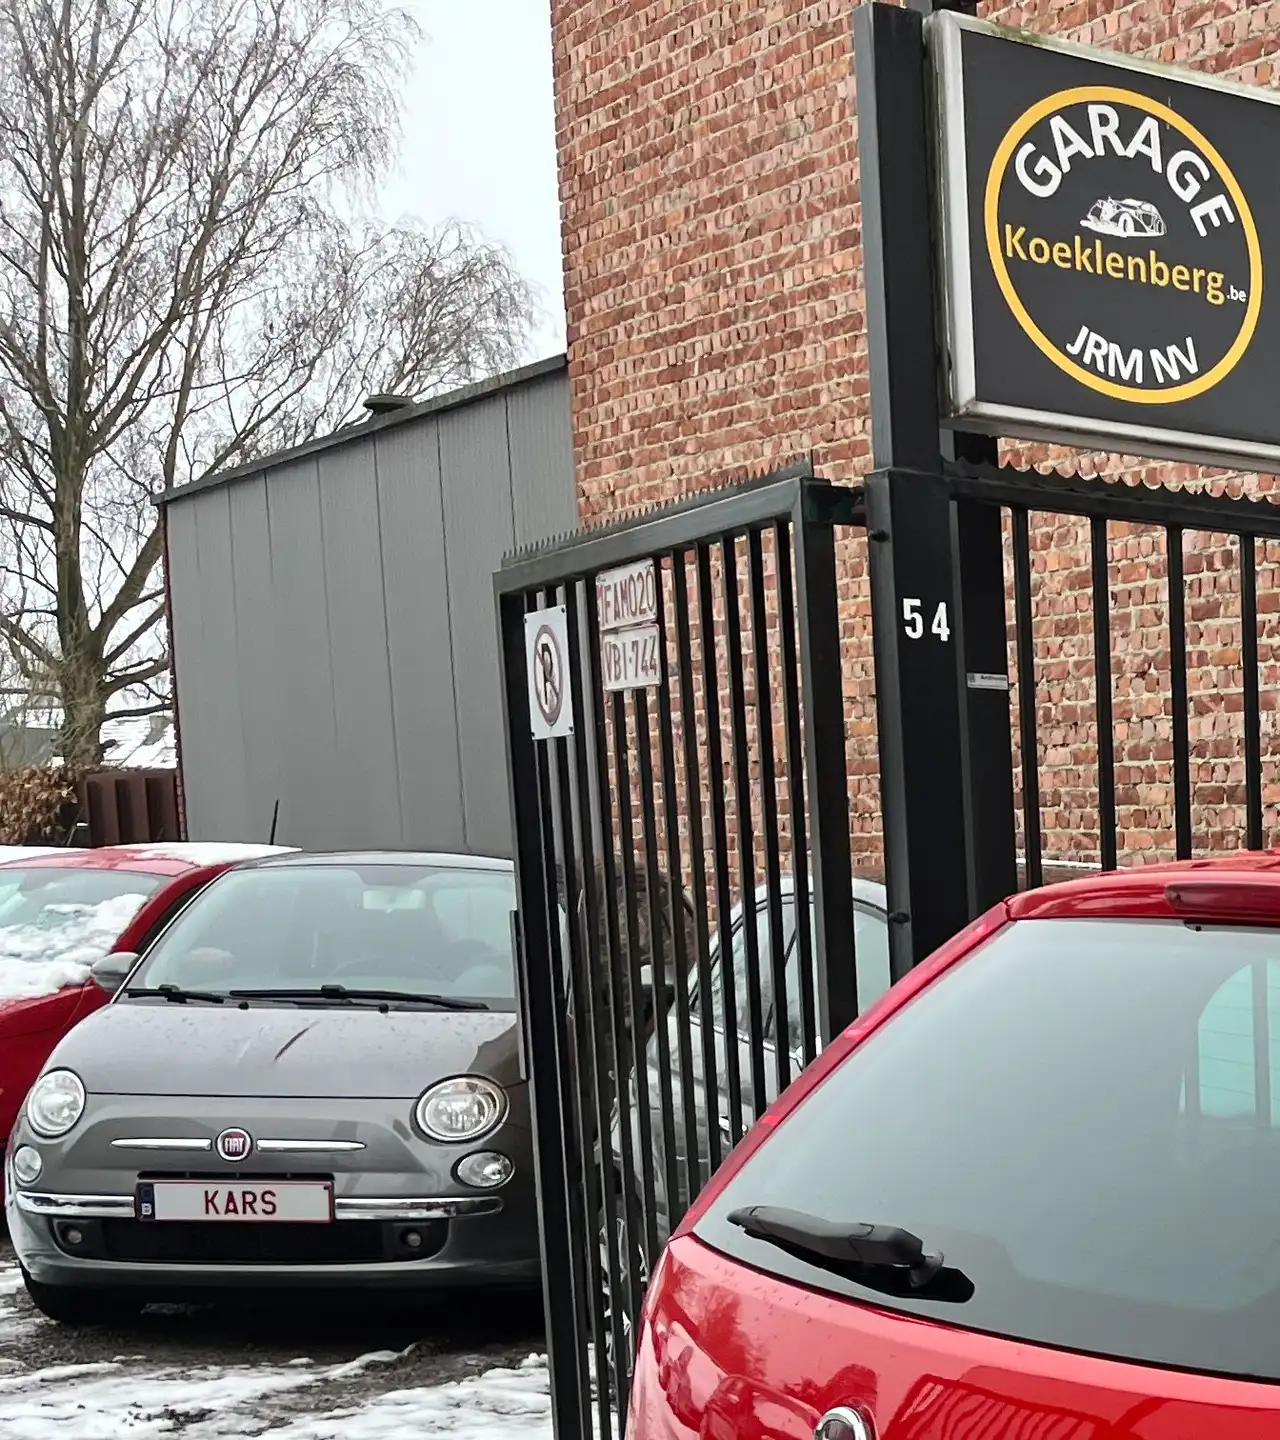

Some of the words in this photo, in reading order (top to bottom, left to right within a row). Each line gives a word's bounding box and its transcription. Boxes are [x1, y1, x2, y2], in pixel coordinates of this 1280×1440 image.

[1014, 104, 1235, 237] GARAGE
[1066, 325, 1143, 384] JRM
[1149, 336, 1199, 384] NV
[902, 598, 951, 642] 54
[224, 1137, 245, 1152] FIAT
[204, 1190, 277, 1216] KARS
